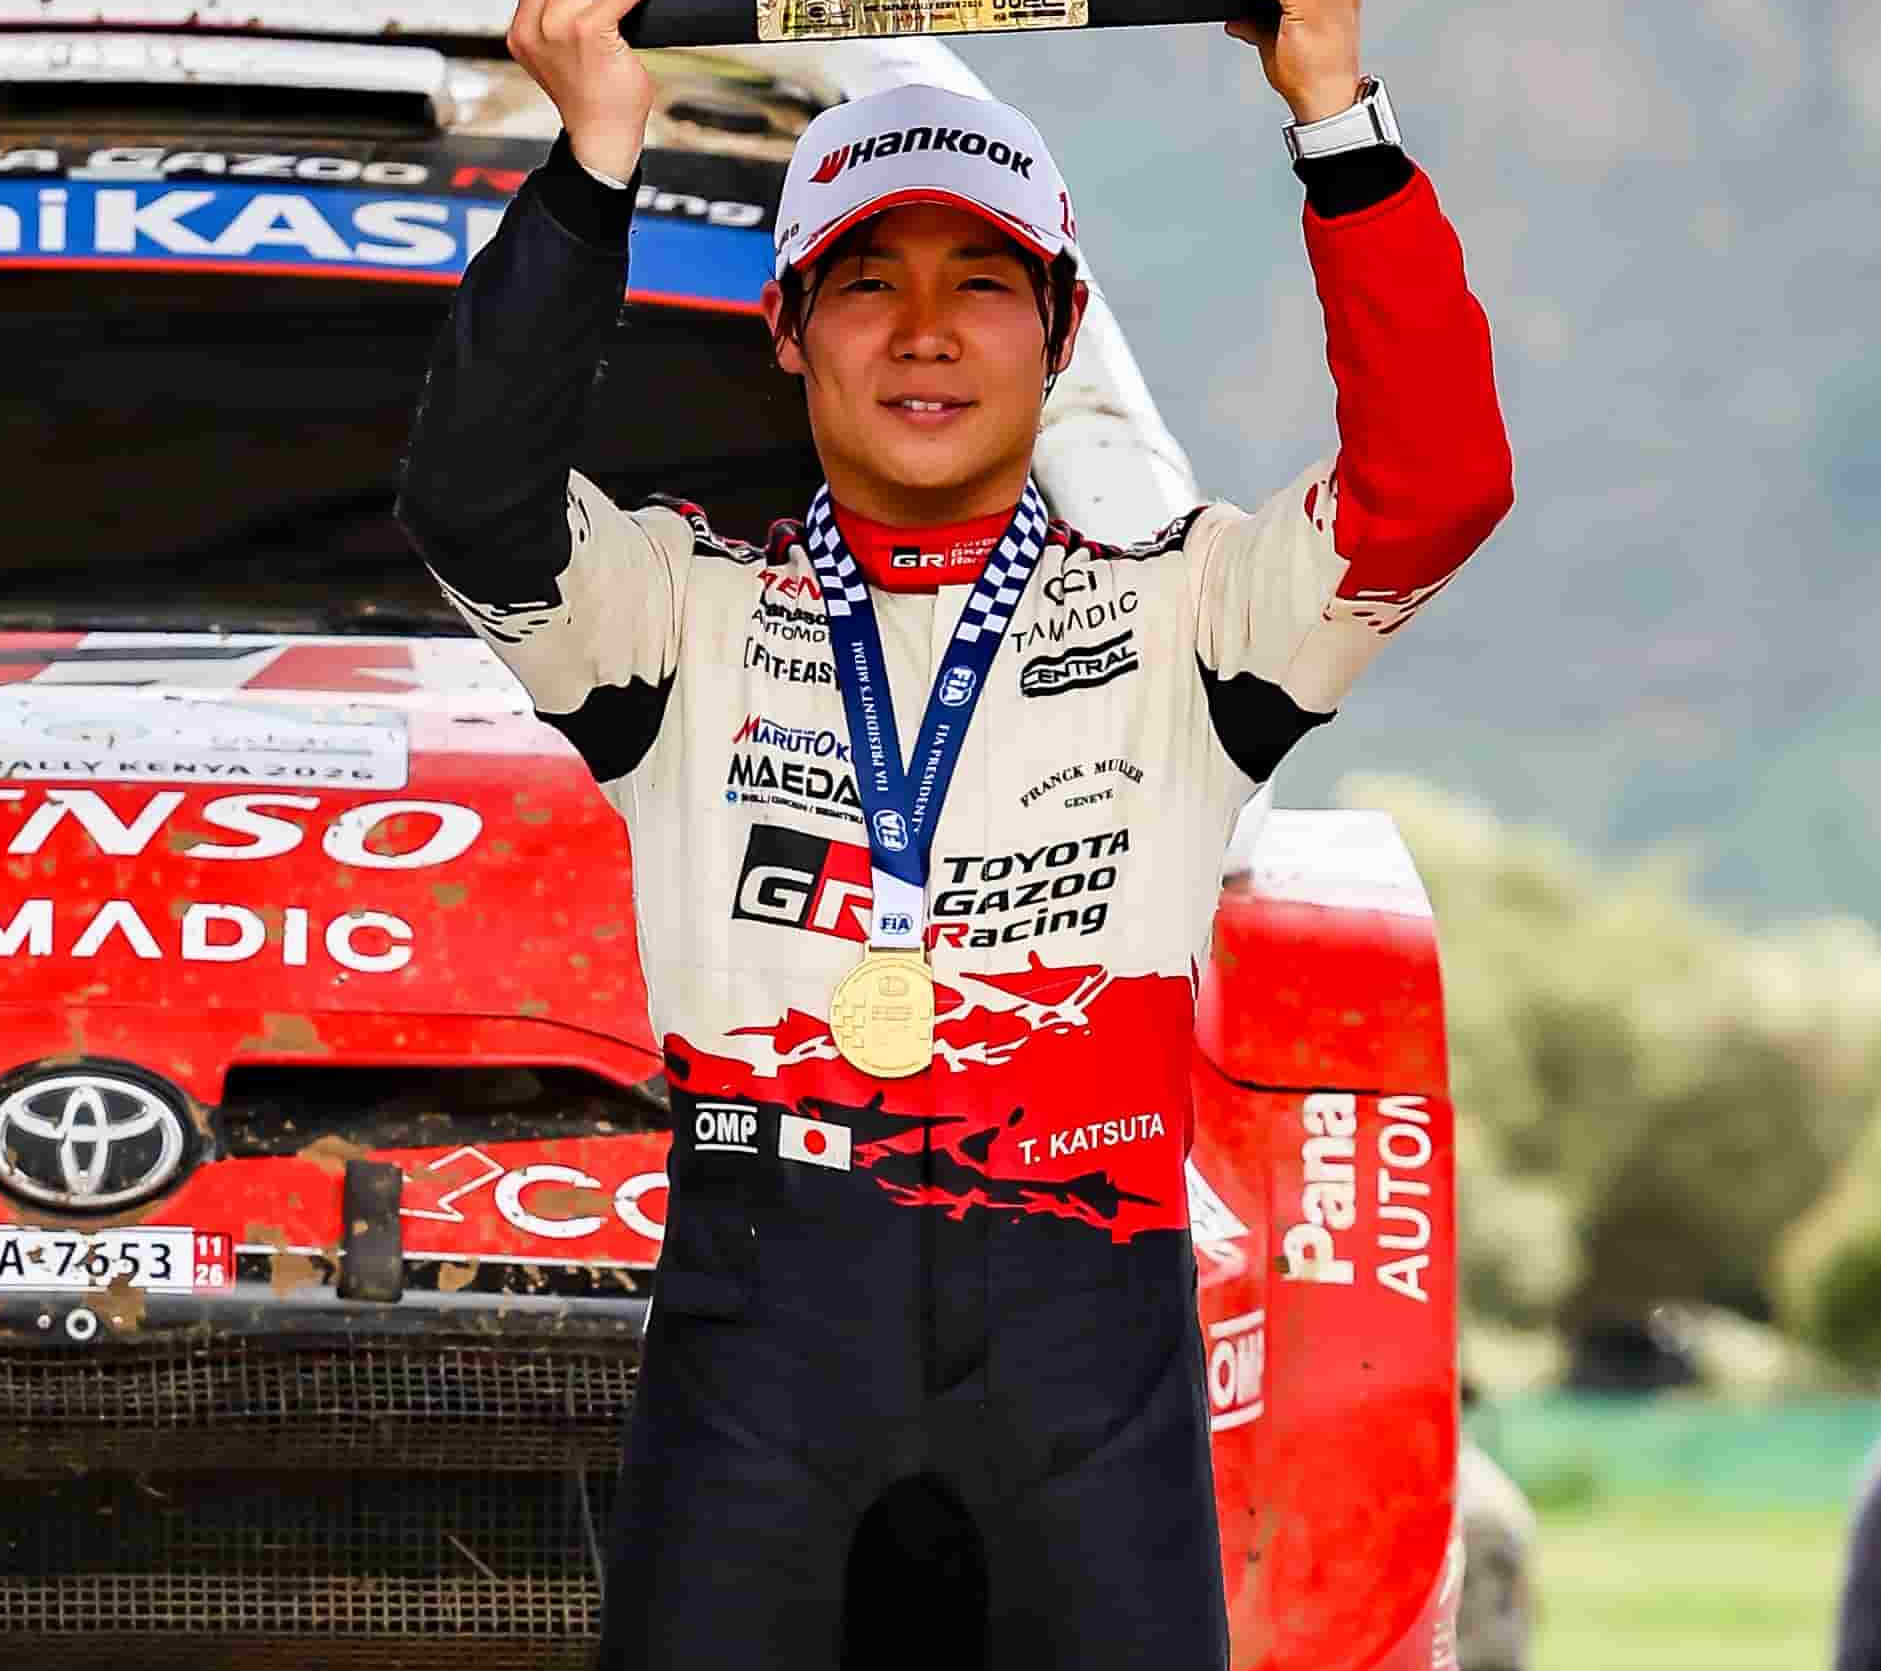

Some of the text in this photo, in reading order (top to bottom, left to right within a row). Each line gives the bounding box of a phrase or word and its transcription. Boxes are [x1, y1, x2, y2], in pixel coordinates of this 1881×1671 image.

[85, 147, 429, 185] GAZOO
[451, 166, 764, 227] Ring
[892, 553, 945, 569] GR
[1010, 590, 1139, 654] TAMADIC
[942, 666, 971, 703] FIA
[1021, 643, 1138, 690] CENTRAL
[118, 760, 252, 777] KENYA
[263, 764, 378, 780] 2026
[727, 753, 863, 808] MAEDA
[1020, 764, 1086, 808] FRANCK
[1063, 787, 1115, 809] GENEVE
[877, 811, 903, 850] FIA
[943, 829, 1131, 884] TOYOTA
[932, 866, 1117, 918] GAZOO
[881, 916, 911, 933] FIA
[927, 902, 1110, 951] Racing
[696, 1111, 758, 1144] OMP
[1019, 1113, 1166, 1165] T. KATSUTA
[494, 1163, 671, 1241] CC
[196, 1235, 223, 1258] 11
[195, 1263, 224, 1286] 26
